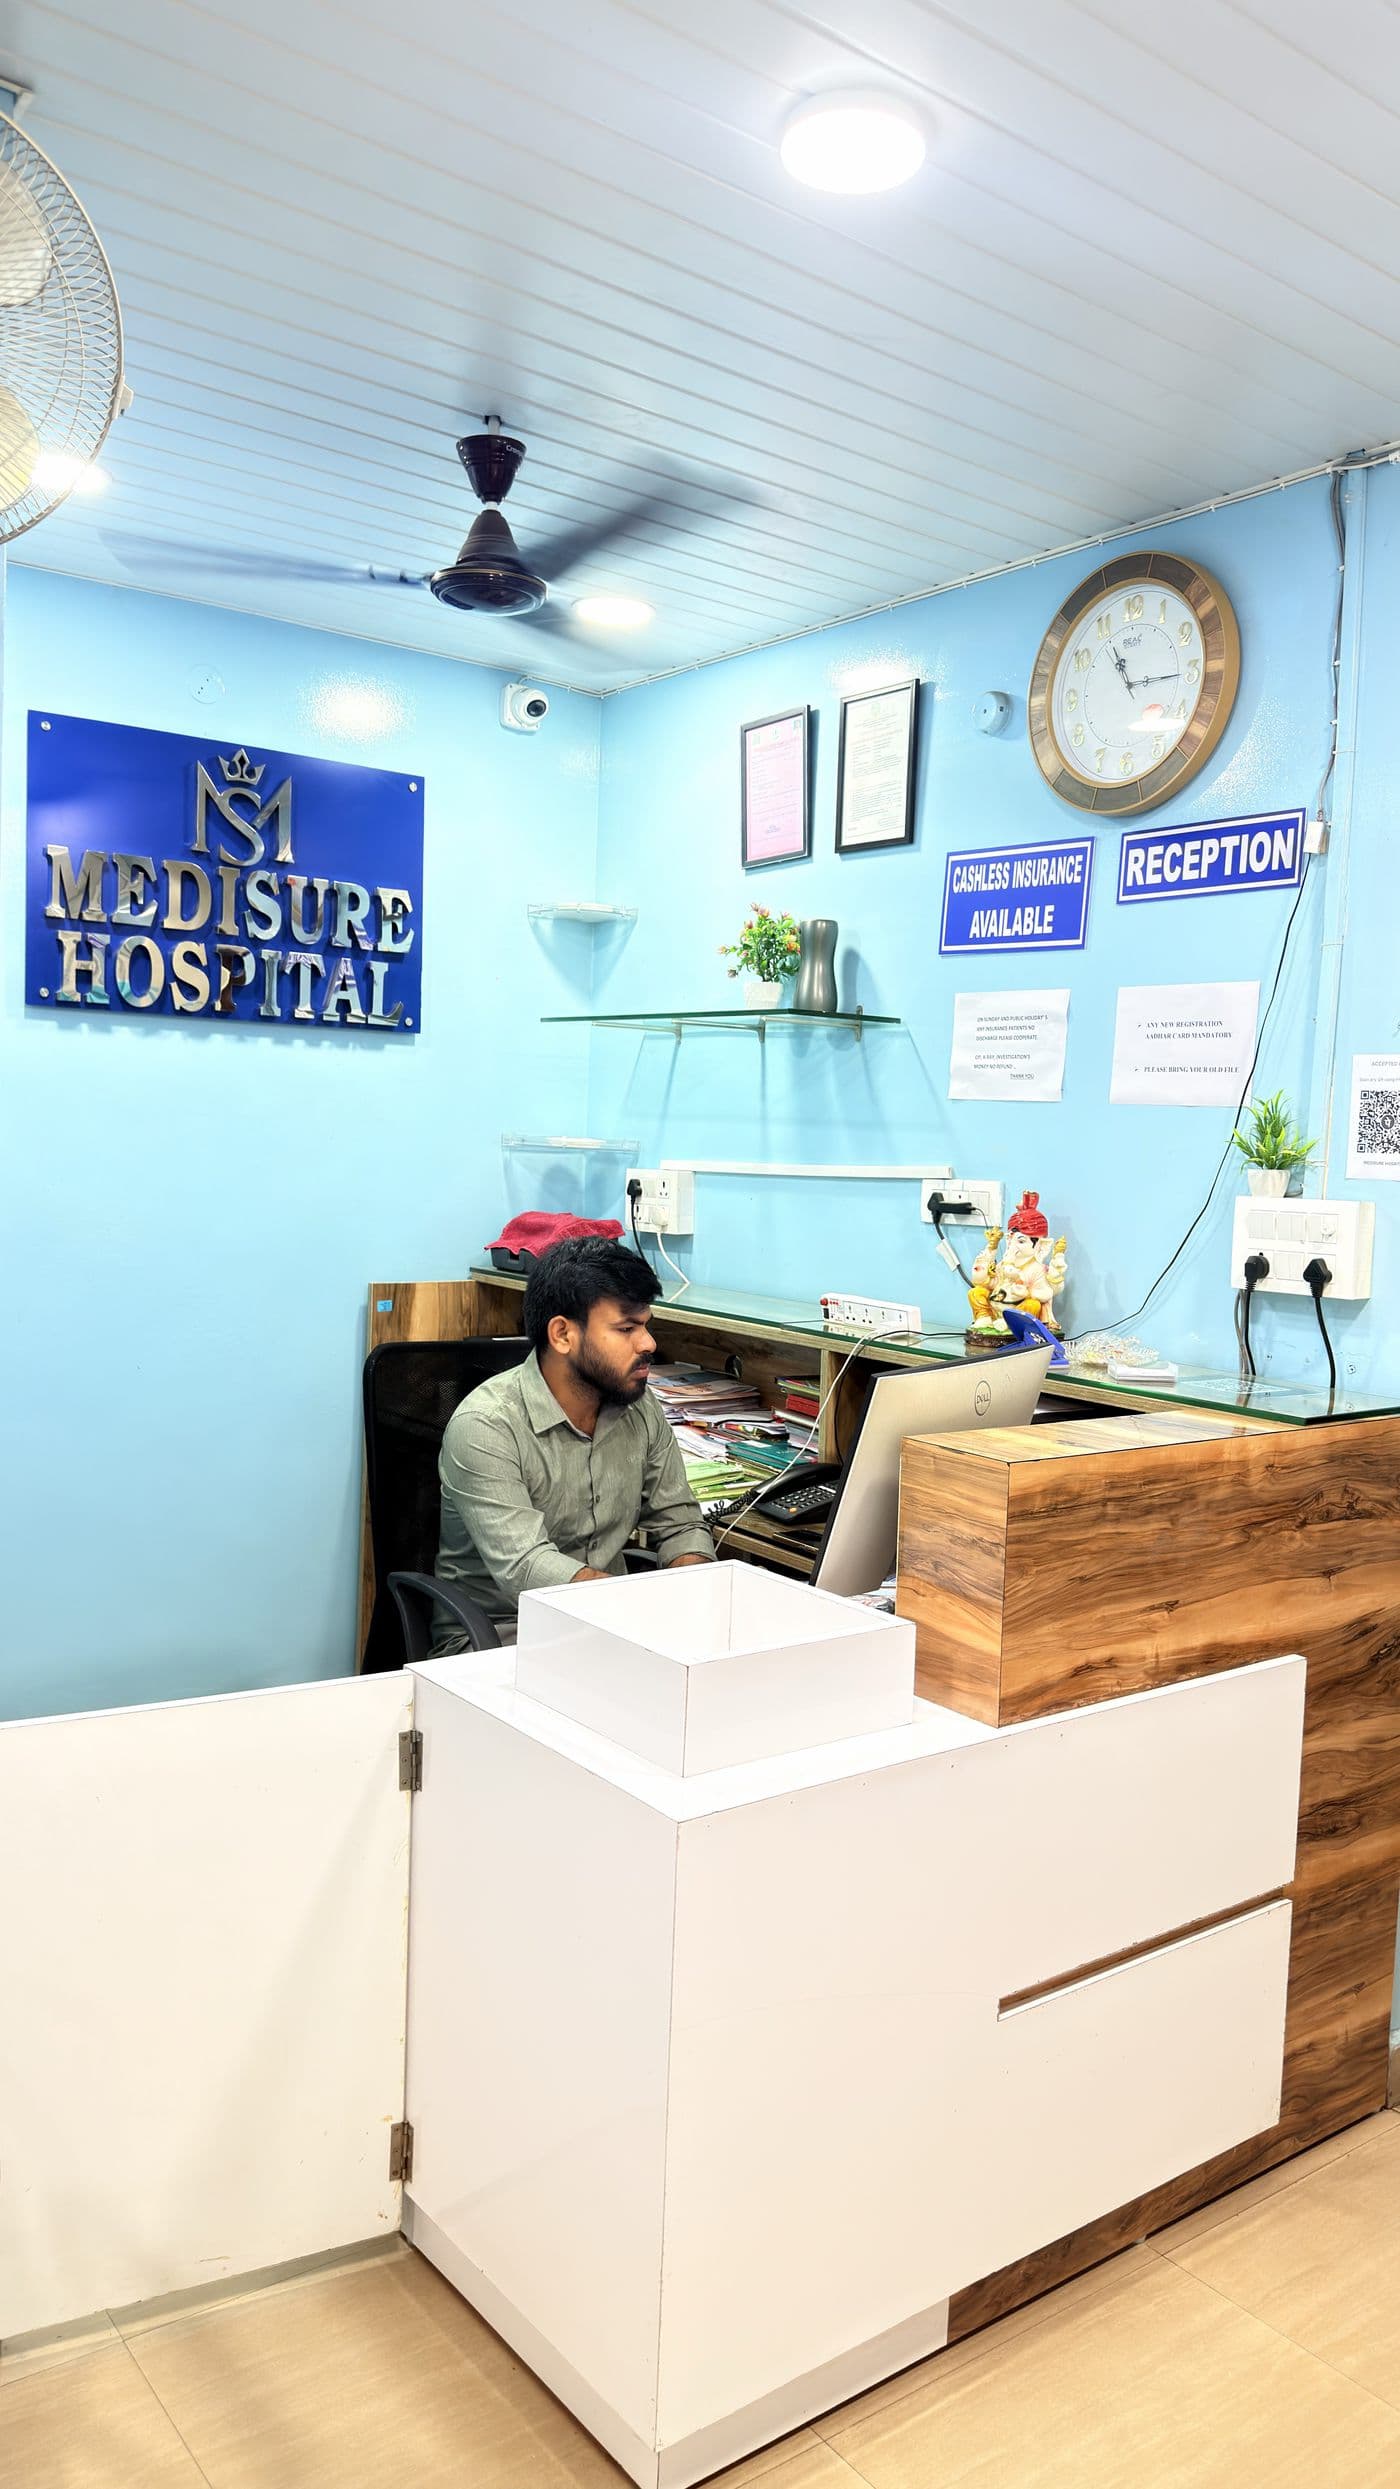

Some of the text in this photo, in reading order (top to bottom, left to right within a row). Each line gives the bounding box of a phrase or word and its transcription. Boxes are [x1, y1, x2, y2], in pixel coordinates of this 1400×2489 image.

[1123, 594, 1144, 623] 12
[1159, 599, 1167, 624] 1
[1097, 613, 1111, 640] 11
[1178, 621, 1192, 647] 2
[1074, 648, 1092, 672] 10
[1184, 658, 1199, 684] 3
[1065, 688, 1078, 712] 9
[1174, 699, 1186, 719] 4
[1072, 723, 1085, 747] 8
[1152, 734, 1165, 759] 5
[1095, 747, 1107, 773] 7
[1120, 752, 1134, 776] 6
[1126, 828, 1295, 887] RECEPTION
[953, 854, 1083, 894] CASHLESS INSURANCE
[44, 844, 416, 953] MEDISURE
[969, 905, 1055, 939] AVAILABLE
[56, 931, 403, 1027] HOSPITAL
